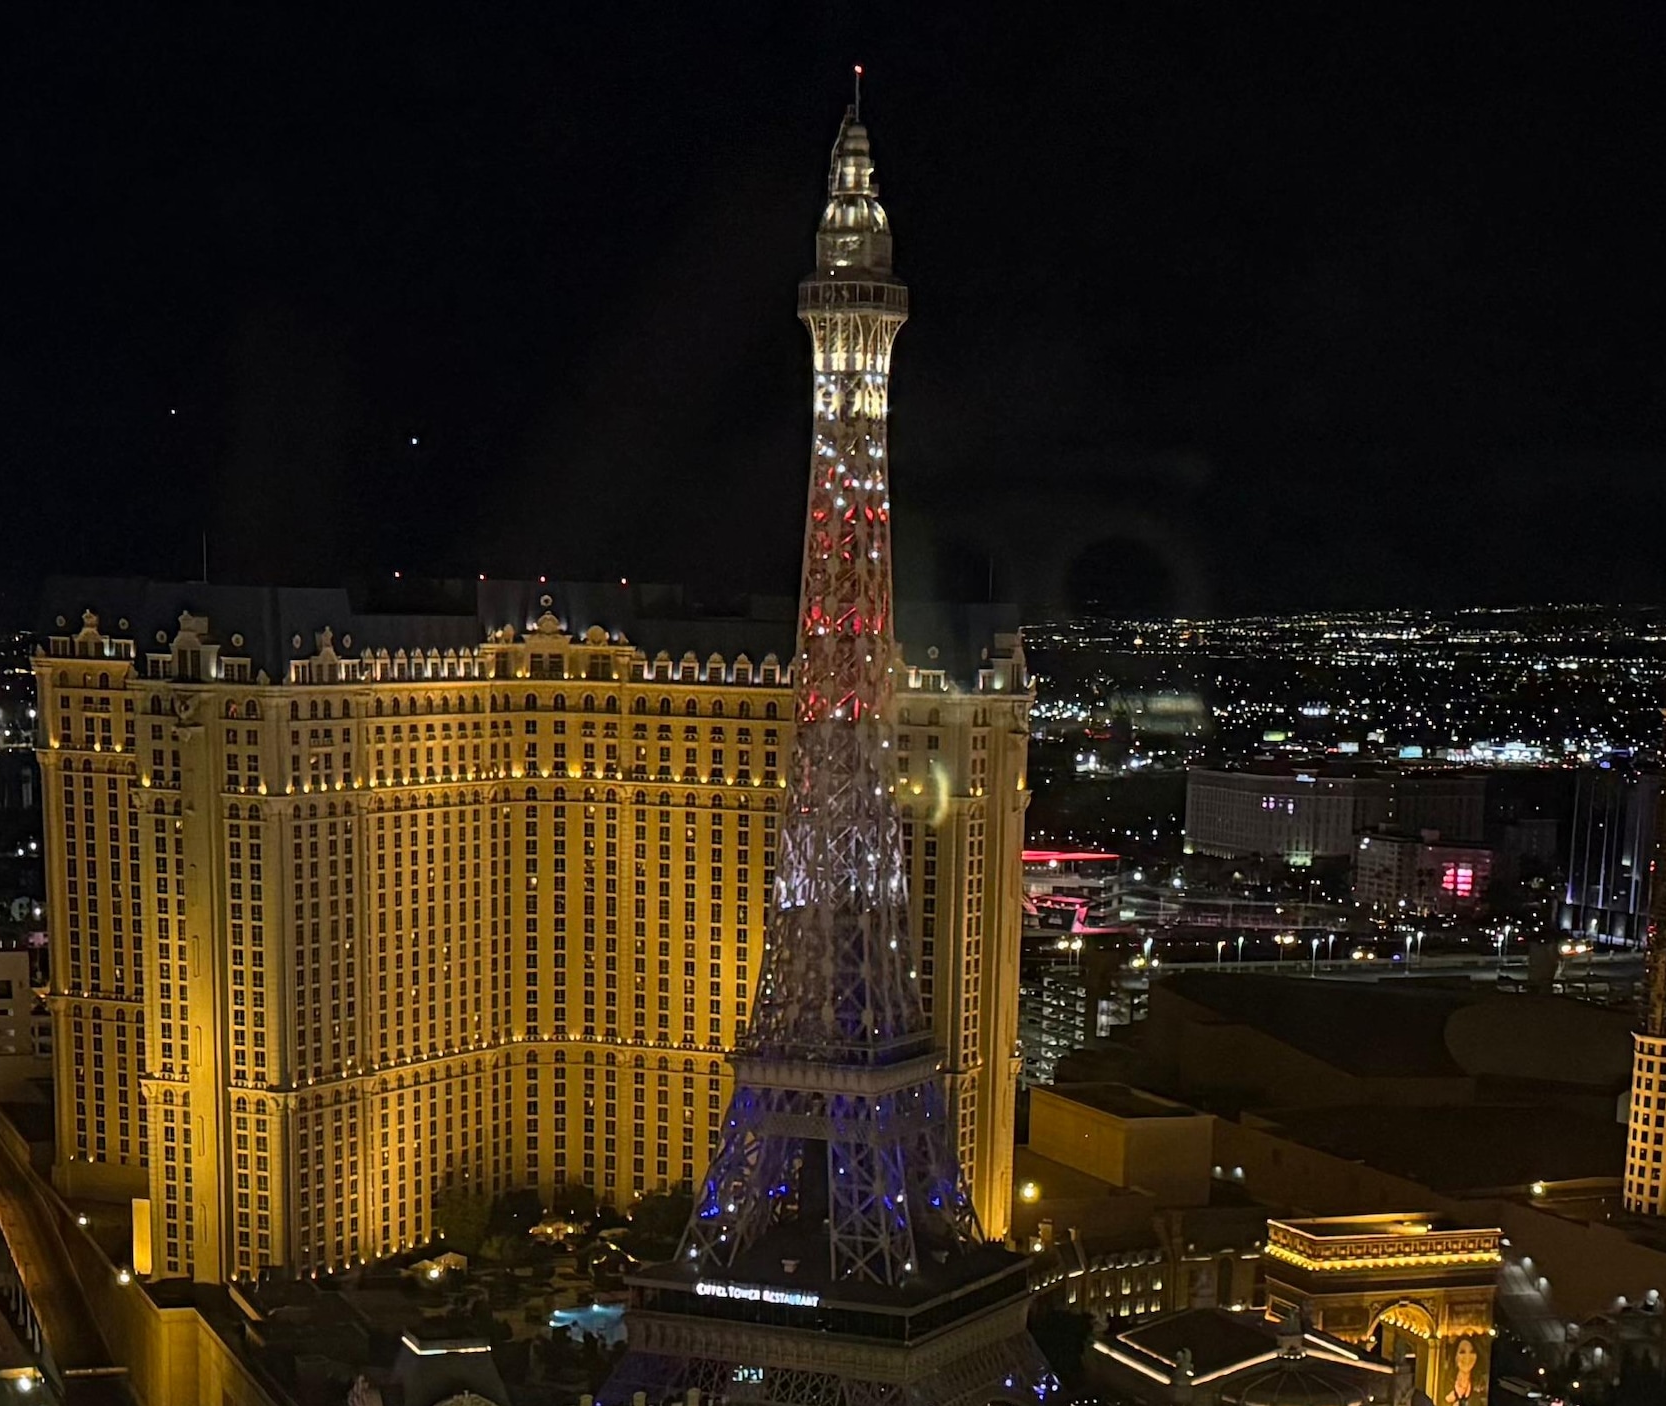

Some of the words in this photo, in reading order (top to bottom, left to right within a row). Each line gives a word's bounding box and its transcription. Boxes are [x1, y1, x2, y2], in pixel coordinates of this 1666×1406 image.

[696, 1283, 728, 1298] EIFFEL
[728, 1285, 761, 1300] TOWER
[762, 1289, 820, 1308] RESTAURANT
